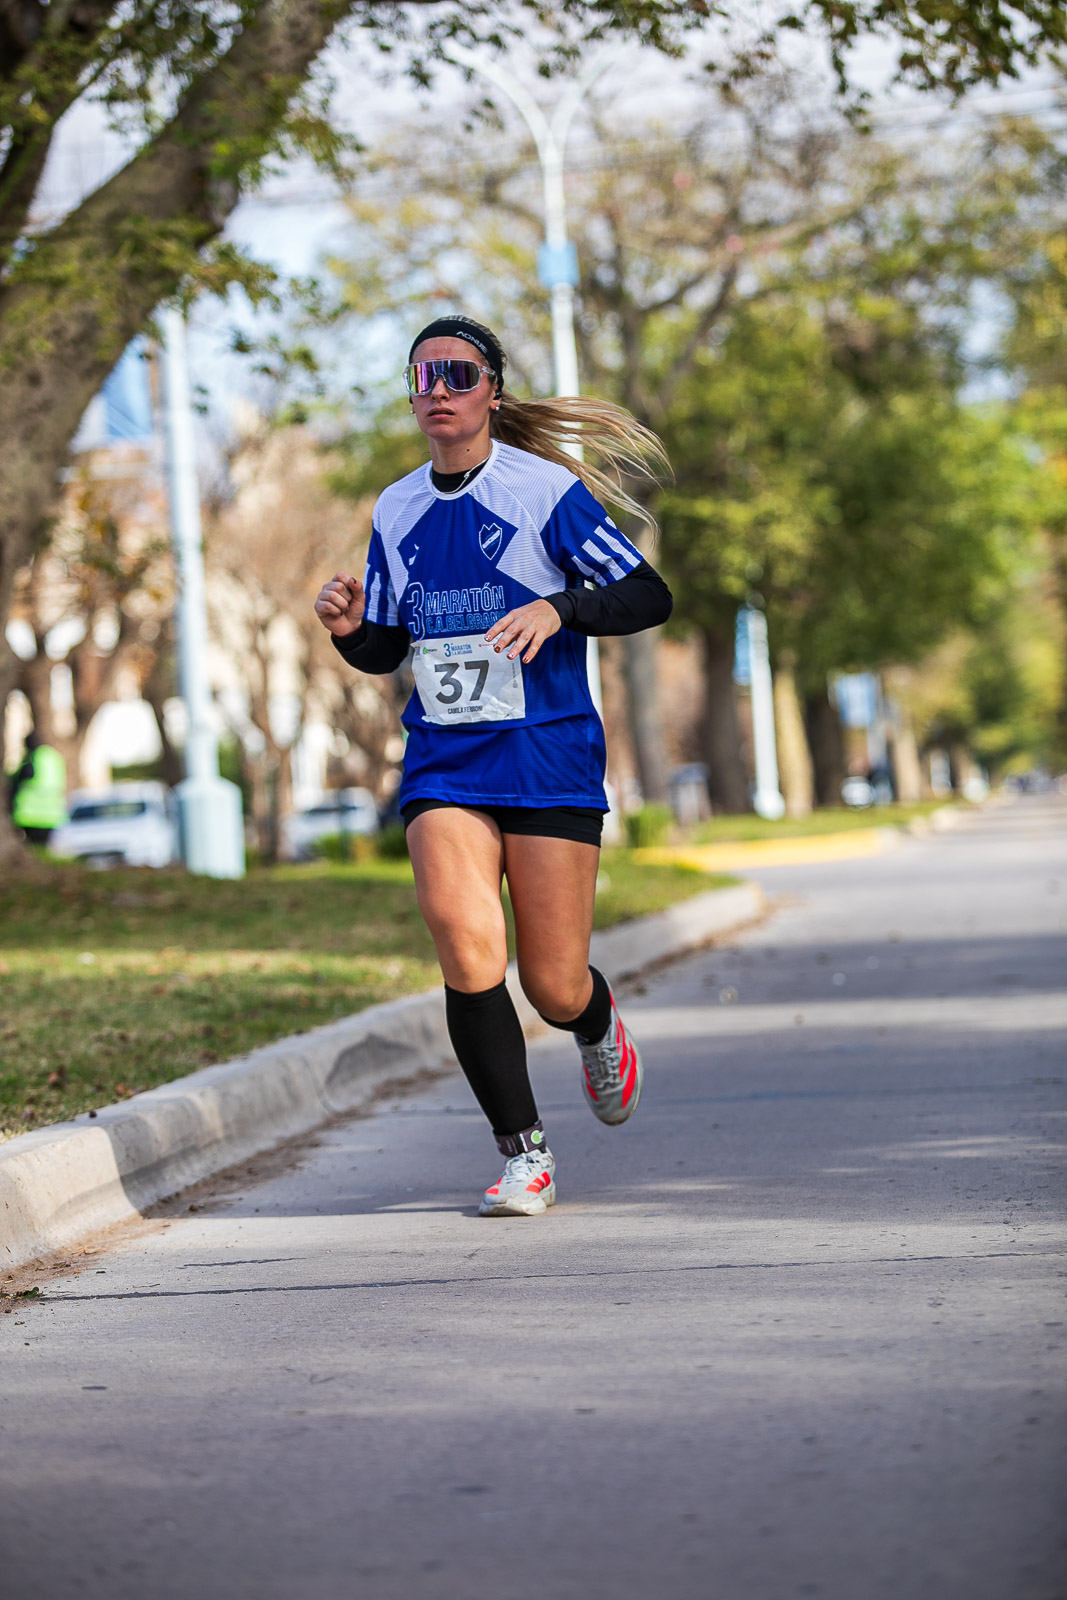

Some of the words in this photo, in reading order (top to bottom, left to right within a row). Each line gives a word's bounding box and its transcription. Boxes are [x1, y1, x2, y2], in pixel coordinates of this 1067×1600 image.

[407, 582, 425, 641] 3
[425, 582, 506, 616] MARATÓN
[434, 660, 489, 704] 37
